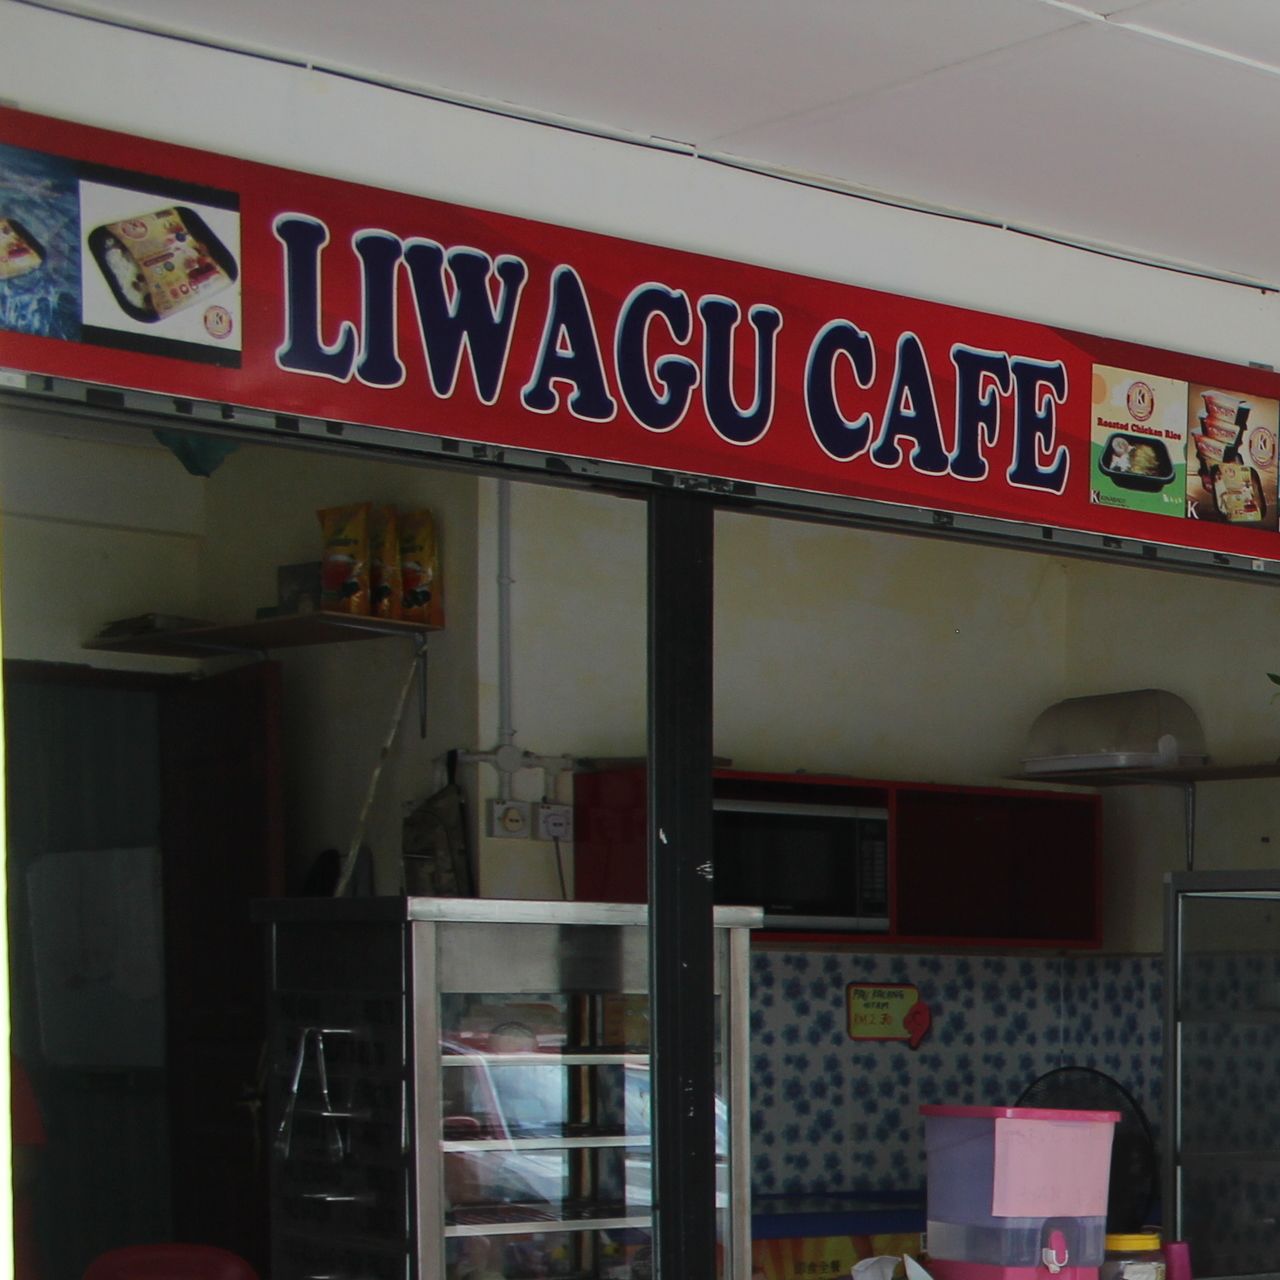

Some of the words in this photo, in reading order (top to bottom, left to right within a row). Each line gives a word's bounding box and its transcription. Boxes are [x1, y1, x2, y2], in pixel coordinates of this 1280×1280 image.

[273, 211, 782, 446] LIWAGU
[804, 319, 1069, 495] CAFE
[1097, 417, 1129, 431] Roasted
[1131, 424, 1163, 438] Chicken
[1165, 429, 1181, 440] Rice
[1188, 501, 1200, 519] K
